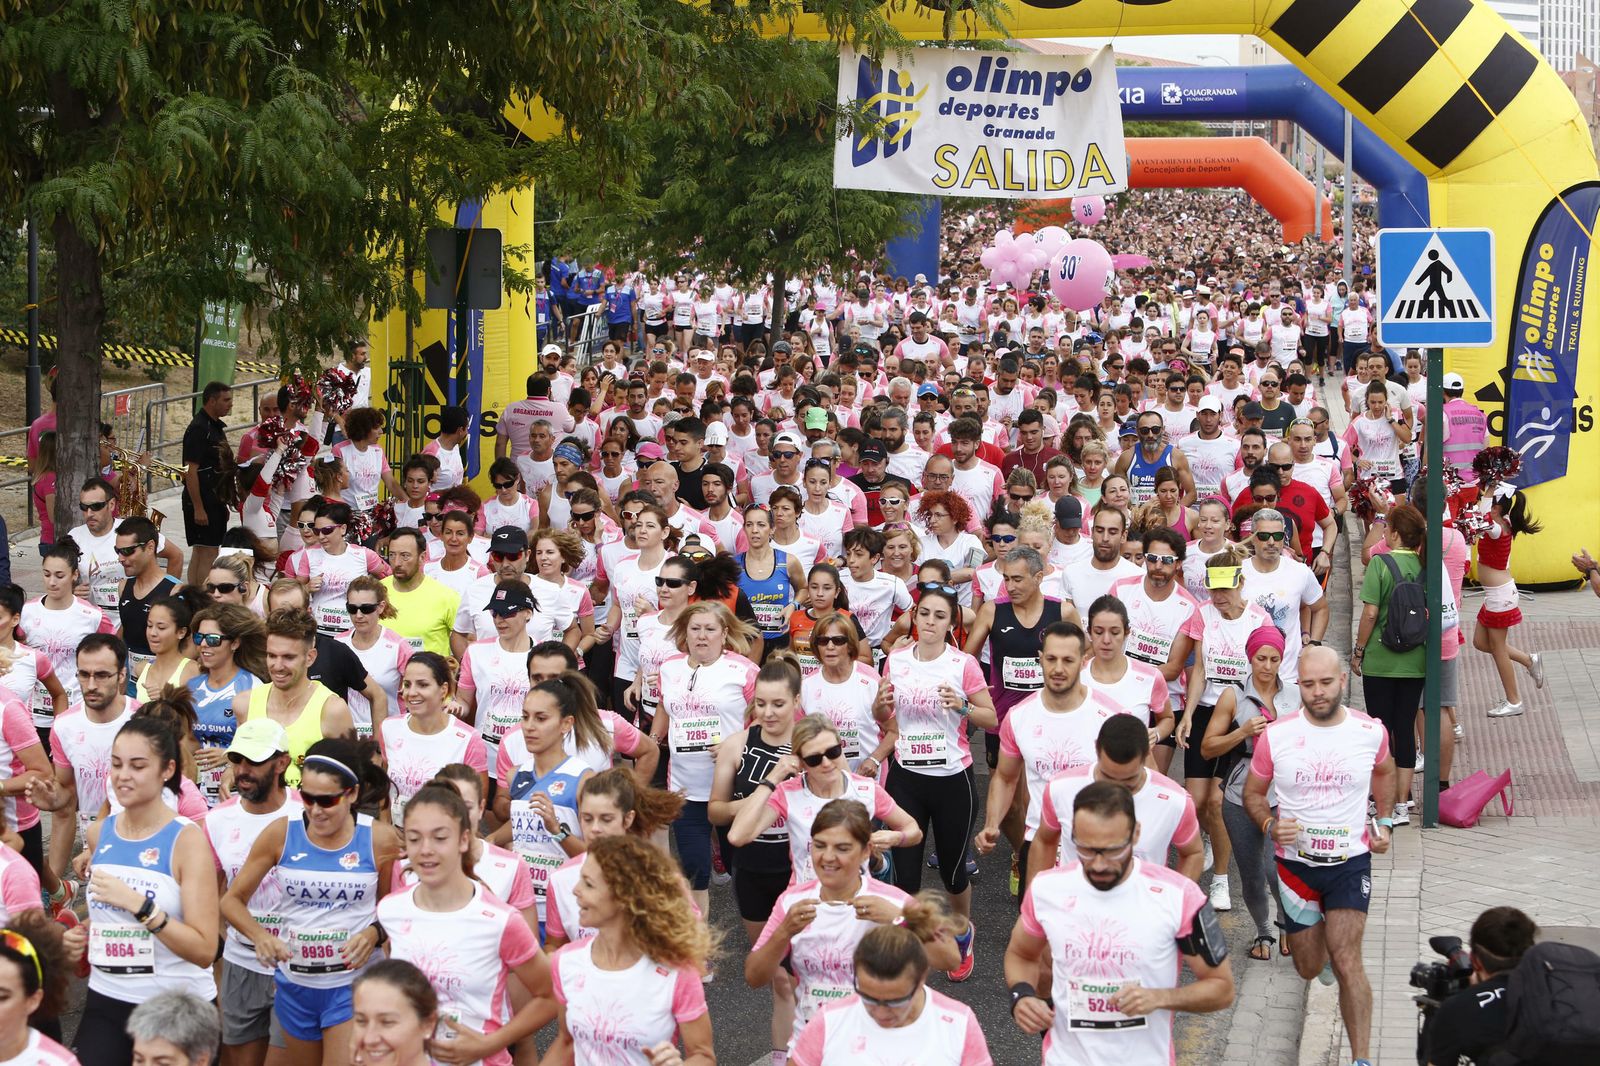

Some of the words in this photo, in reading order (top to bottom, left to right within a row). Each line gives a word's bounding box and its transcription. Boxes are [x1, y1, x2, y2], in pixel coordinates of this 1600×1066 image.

[945, 56, 1093, 107] olimpo
[1183, 88, 1238, 98] CAJAGRANADA
[938, 97, 1040, 121] deportes
[982, 124, 1056, 140] Granada
[931, 142, 1117, 191] SALIDA
[1198, 165, 1232, 173] Deportes
[1082, 204, 1093, 217] 38
[1573, 257, 1586, 307] RUNNING
[1521, 243, 1555, 344] olimpo
[1542, 286, 1561, 349] deportes
[1568, 320, 1579, 351] TRAIL
[322, 614, 342, 624] 8056
[1136, 633, 1171, 648] COVIRAN
[1136, 642, 1159, 656] 9093
[1213, 657, 1247, 667] COVIRAN
[1013, 669, 1036, 679] 2594
[1215, 666, 1237, 677] 9252
[682, 719, 720, 729] COVIRAN
[686, 730, 708, 741] 7285
[906, 732, 946, 742] COVIRAN
[911, 744, 934, 755] 5785
[1306, 826, 1350, 836] COVIRAN
[1311, 838, 1335, 851] 7169
[310, 880, 369, 890] ATLETISMO
[286, 885, 366, 902] CAXAR
[101, 926, 151, 939] COVIRAN
[297, 931, 349, 943] COVIRAN
[105, 943, 136, 958] 8864
[301, 945, 334, 960] 8936
